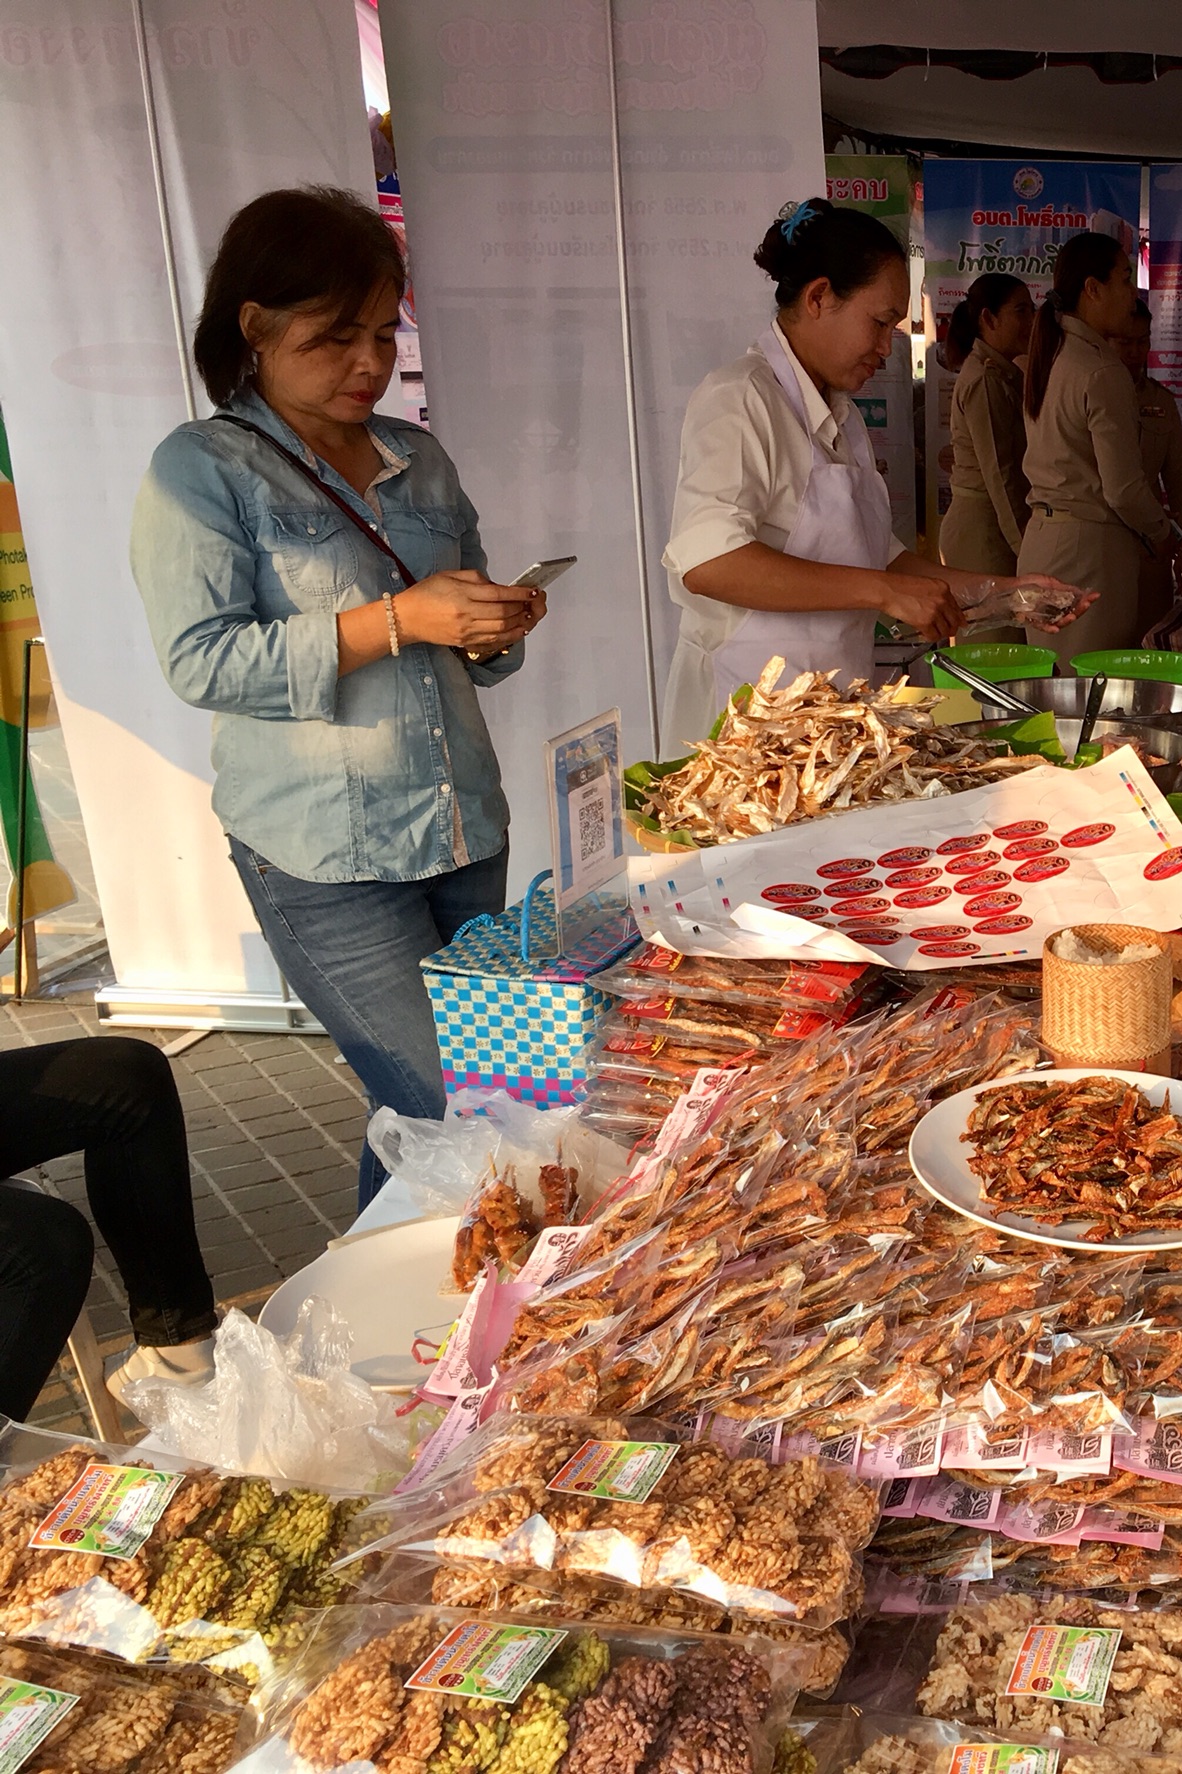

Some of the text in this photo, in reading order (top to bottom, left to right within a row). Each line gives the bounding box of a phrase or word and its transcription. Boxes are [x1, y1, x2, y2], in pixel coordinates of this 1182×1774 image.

[972, 203, 1088, 228] อบต.โพธิ์ตาก
